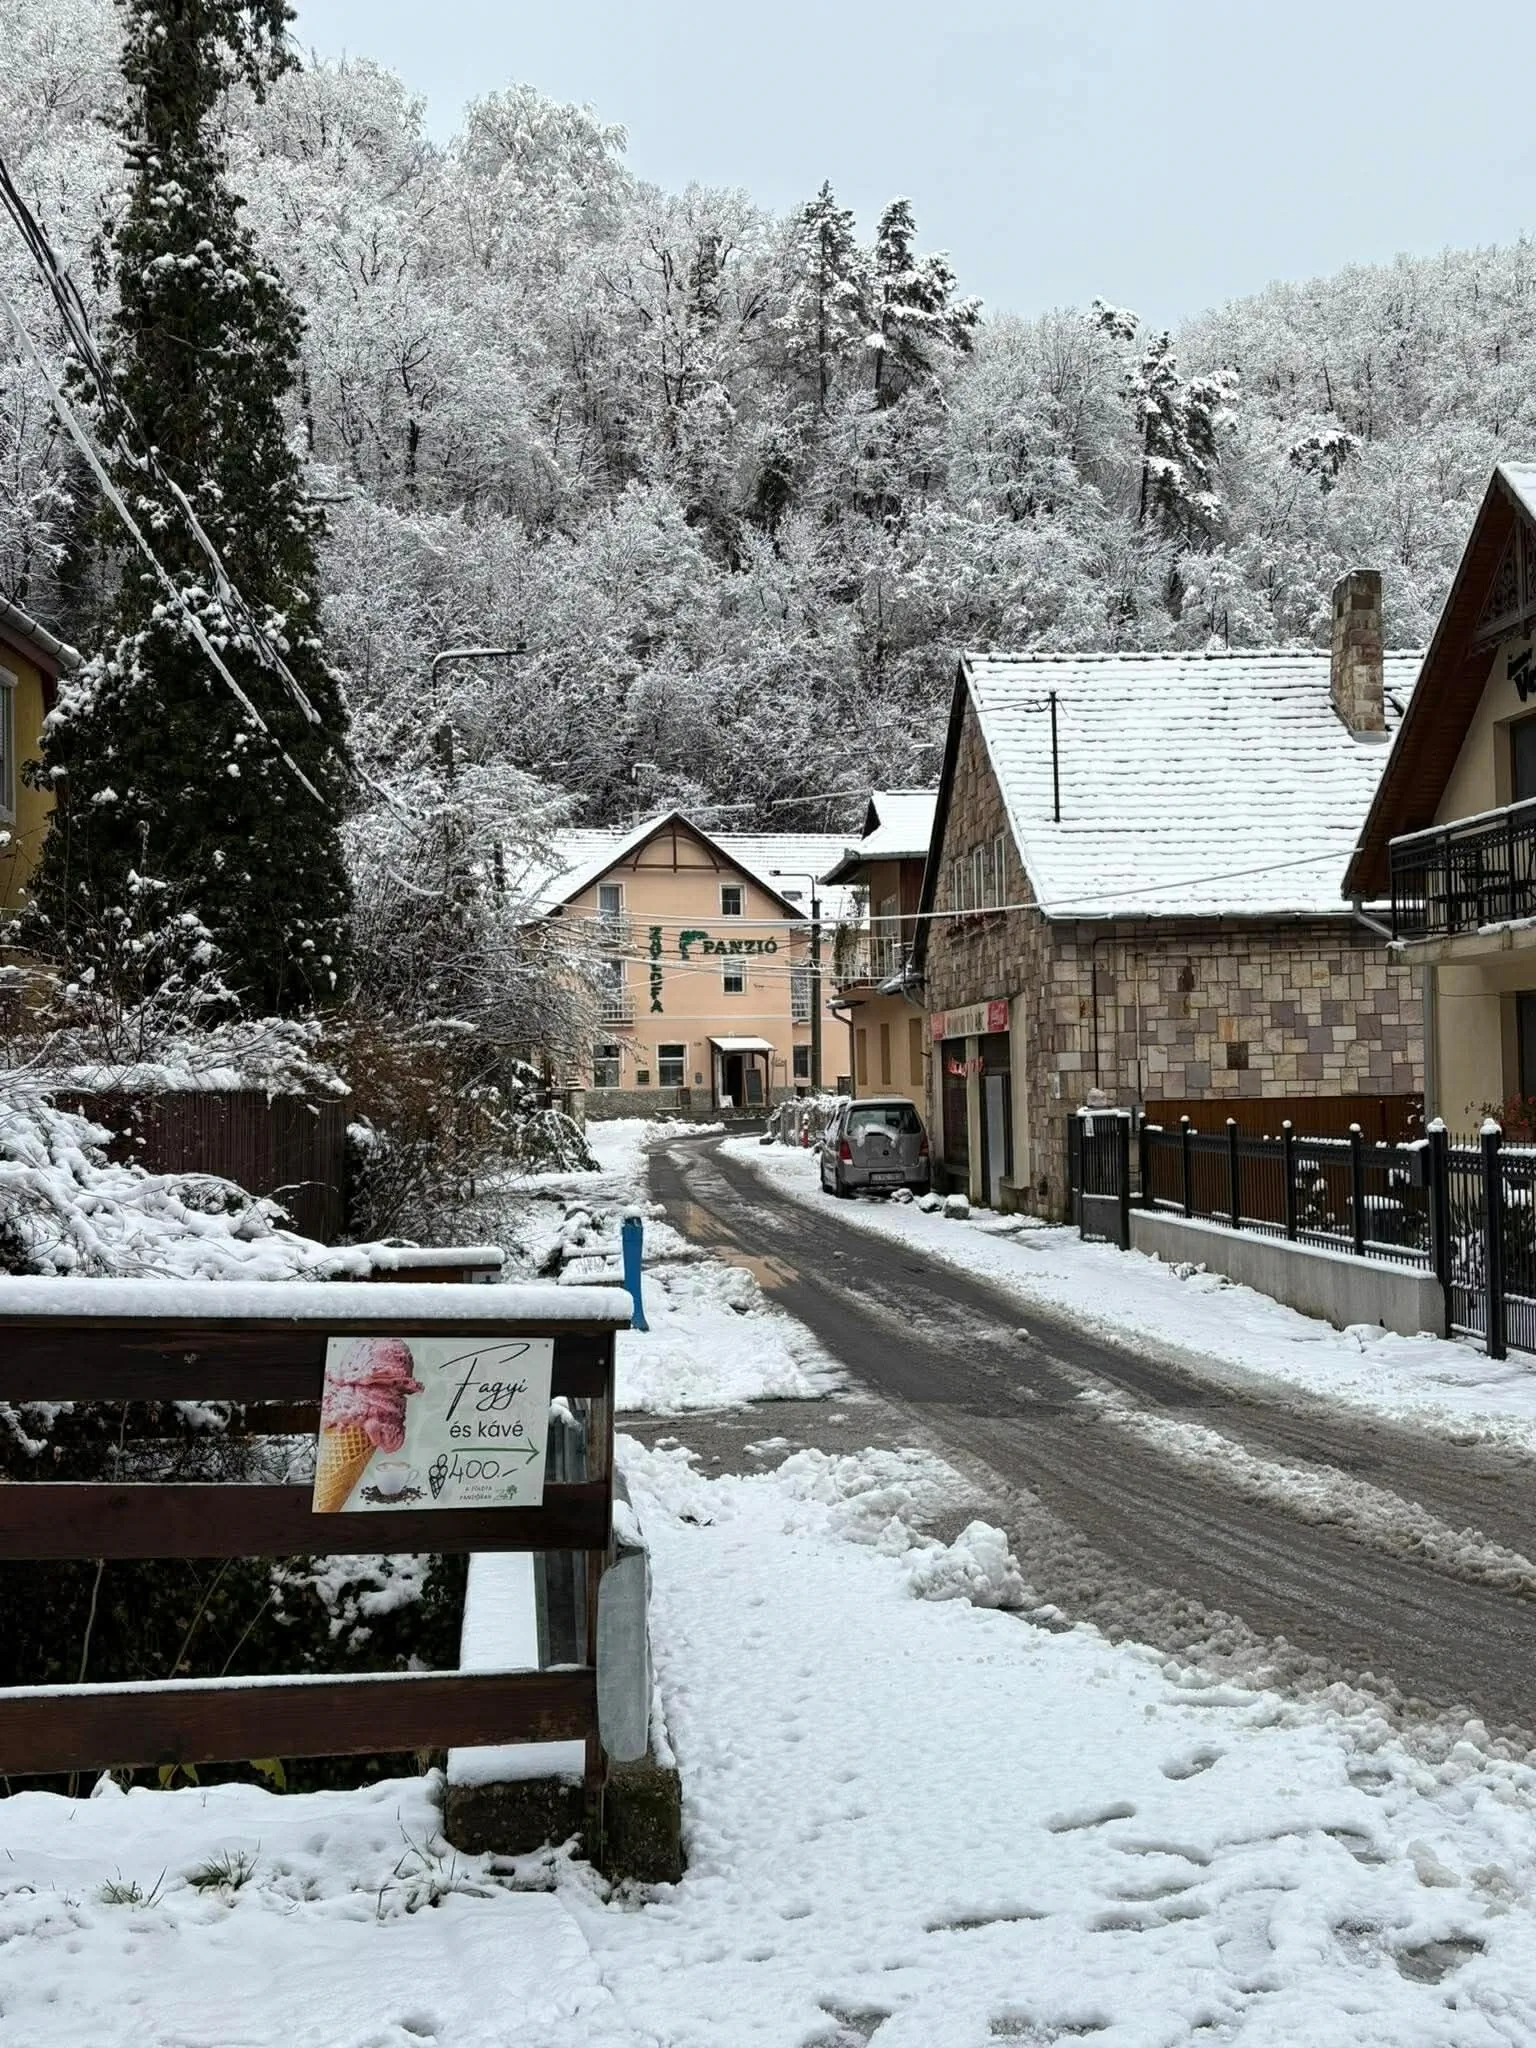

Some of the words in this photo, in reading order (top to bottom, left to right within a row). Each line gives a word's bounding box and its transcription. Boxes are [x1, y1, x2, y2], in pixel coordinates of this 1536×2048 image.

[703, 936, 777, 954] PANZIÓ
[439, 1342, 530, 1421] Fagyi
[450, 1420, 471, 1438] és
[478, 1420, 523, 1438] kávé
